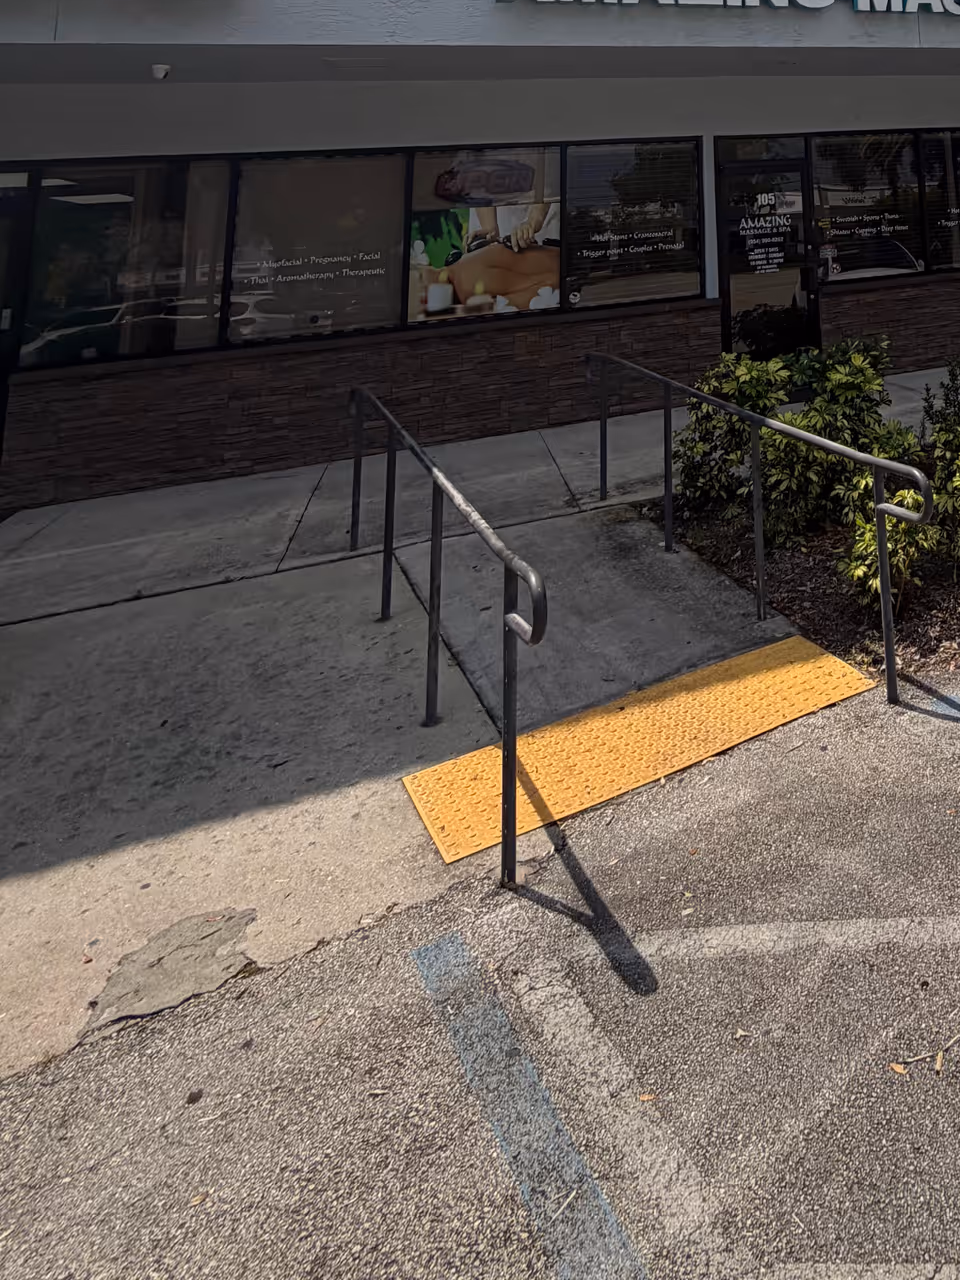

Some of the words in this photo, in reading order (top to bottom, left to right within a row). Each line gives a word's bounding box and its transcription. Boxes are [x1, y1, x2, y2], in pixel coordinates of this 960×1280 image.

[755, 192, 775, 205] 105
[739, 214, 792, 229] AMAZING
[609, 232, 628, 241] Stone
[739, 227, 771, 236] MASSAGE
[581, 249, 606, 259] Trigger
[606, 248, 623, 257] point
[628, 244, 653, 254] Couples
[658, 240, 685, 251] Prenatal
[261, 257, 302, 271] Myofacial
[309, 254, 352, 266] Pregnancy
[358, 251, 381, 261] Facial
[249, 276, 269, 285] Thai
[275, 271, 335, 283] Aromatherapy
[341, 267, 386, 279] Therapeutic
